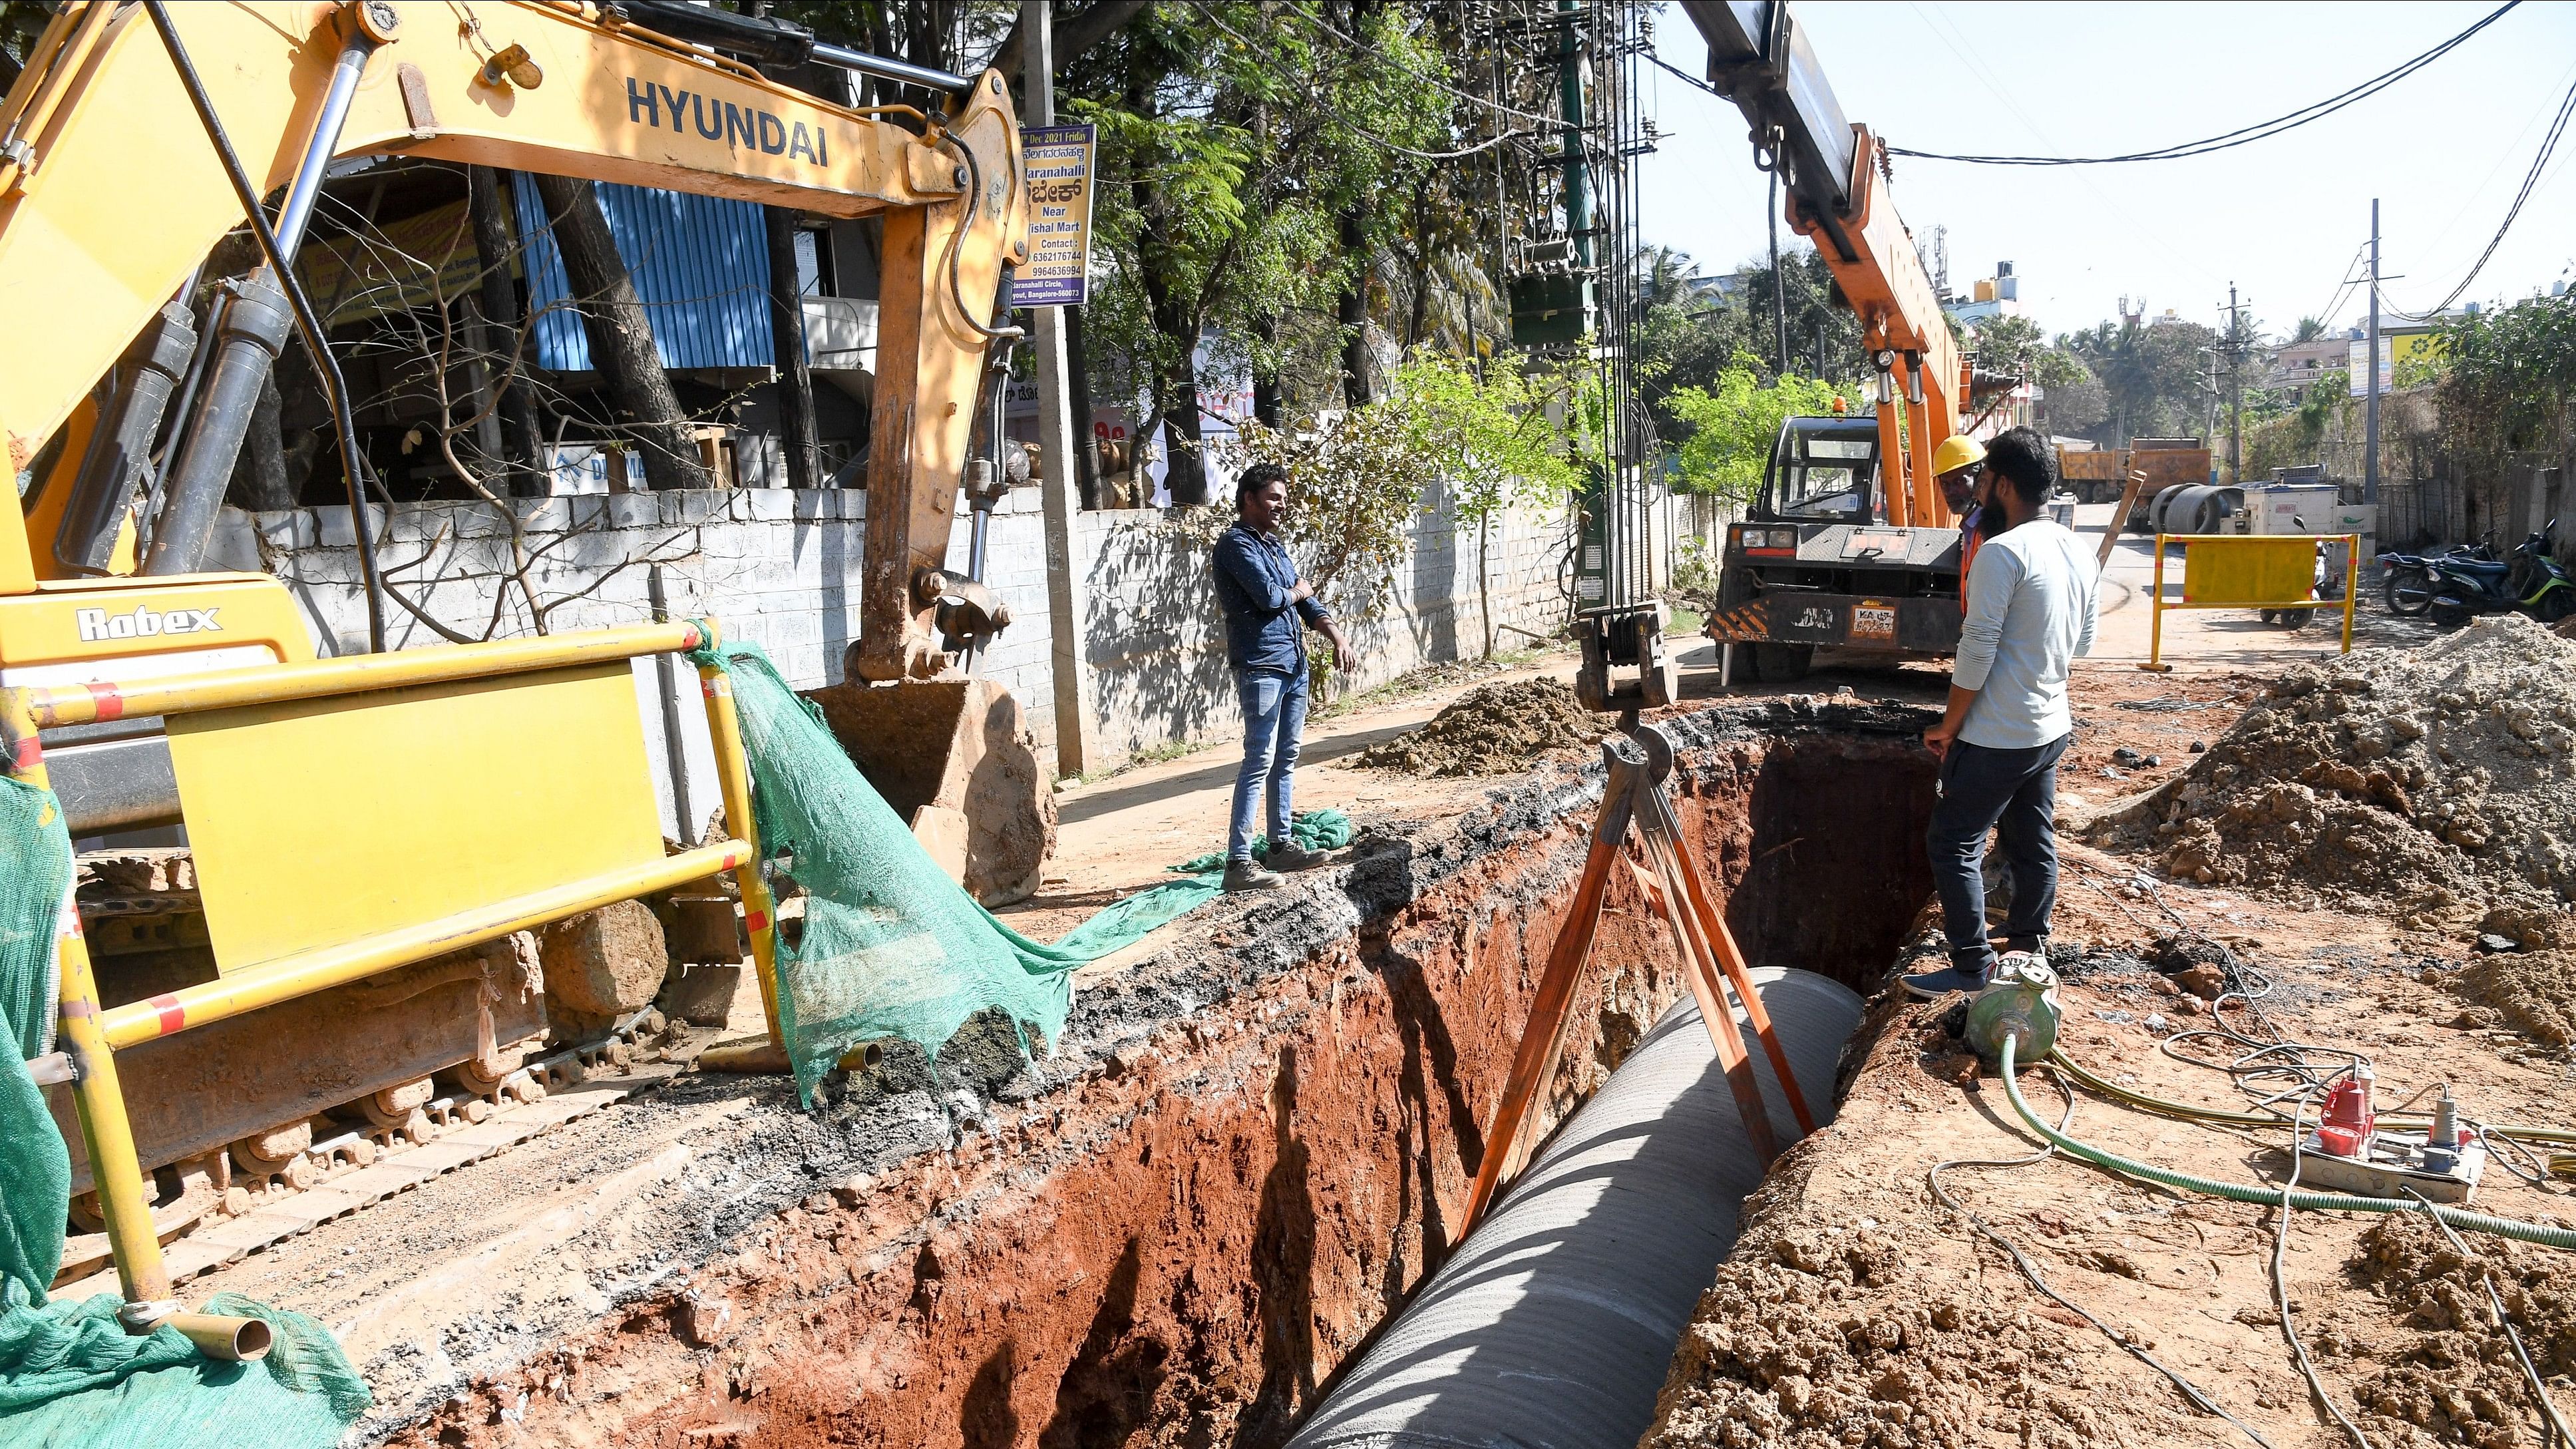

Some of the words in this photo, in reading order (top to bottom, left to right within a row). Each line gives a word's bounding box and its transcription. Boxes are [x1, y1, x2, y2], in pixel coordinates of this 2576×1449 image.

[626, 77, 828, 167] HYUNDAI
[1030, 134, 1042, 144] Dec
[1045, 133, 1063, 142] 2021
[1065, 132, 1086, 142] Friday
[1043, 207, 1066, 216] Near
[1057, 222, 1079, 232] Mart
[1041, 240, 1072, 248] Contact
[1033, 252, 1081, 262] 6362176744
[1033, 266, 1081, 276] 9964636994
[1028, 290, 1079, 299] Bangalore-560073
[76, 605, 224, 642] Robex
